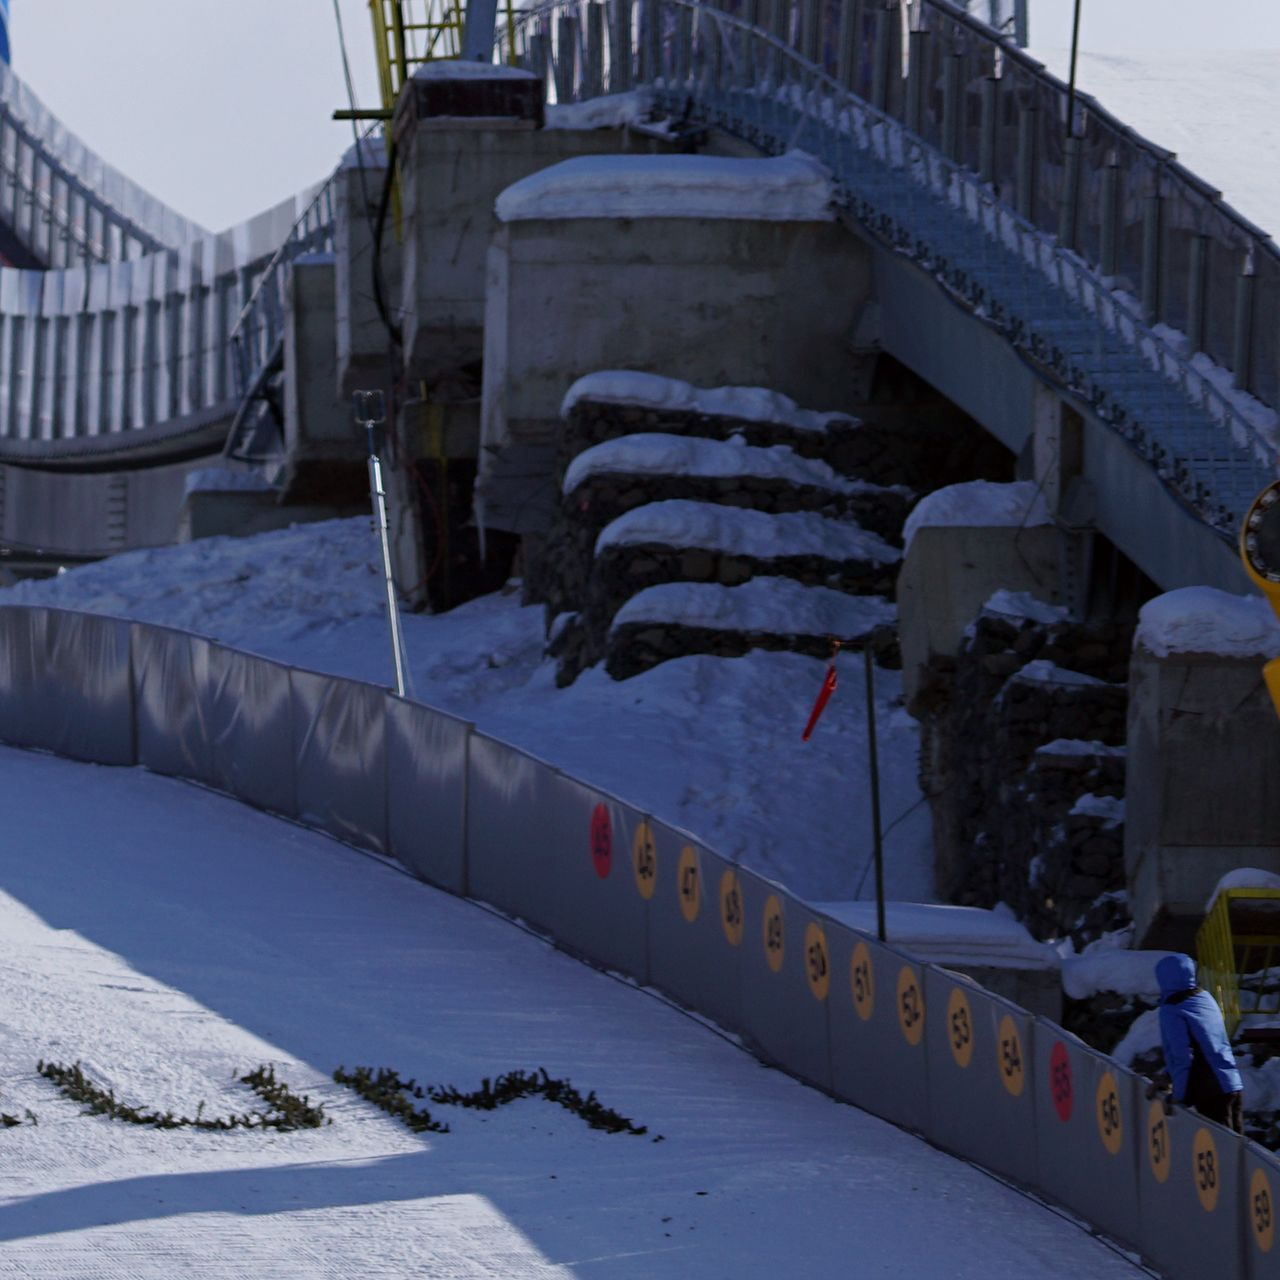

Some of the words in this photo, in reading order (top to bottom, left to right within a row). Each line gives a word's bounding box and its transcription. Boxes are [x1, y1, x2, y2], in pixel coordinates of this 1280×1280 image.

[683, 866, 697, 902] 47
[808, 941, 827, 983] 50
[855, 960, 872, 1003] 51
[901, 984, 921, 1029] 52
[951, 1007, 970, 1050] 53
[1002, 1035, 1021, 1077] 54
[1054, 1061, 1073, 1105] 55
[1102, 1091, 1120, 1137] 56
[1151, 1119, 1167, 1165] 57
[1197, 1149, 1217, 1192] 58
[1254, 1188, 1272, 1233] 59
